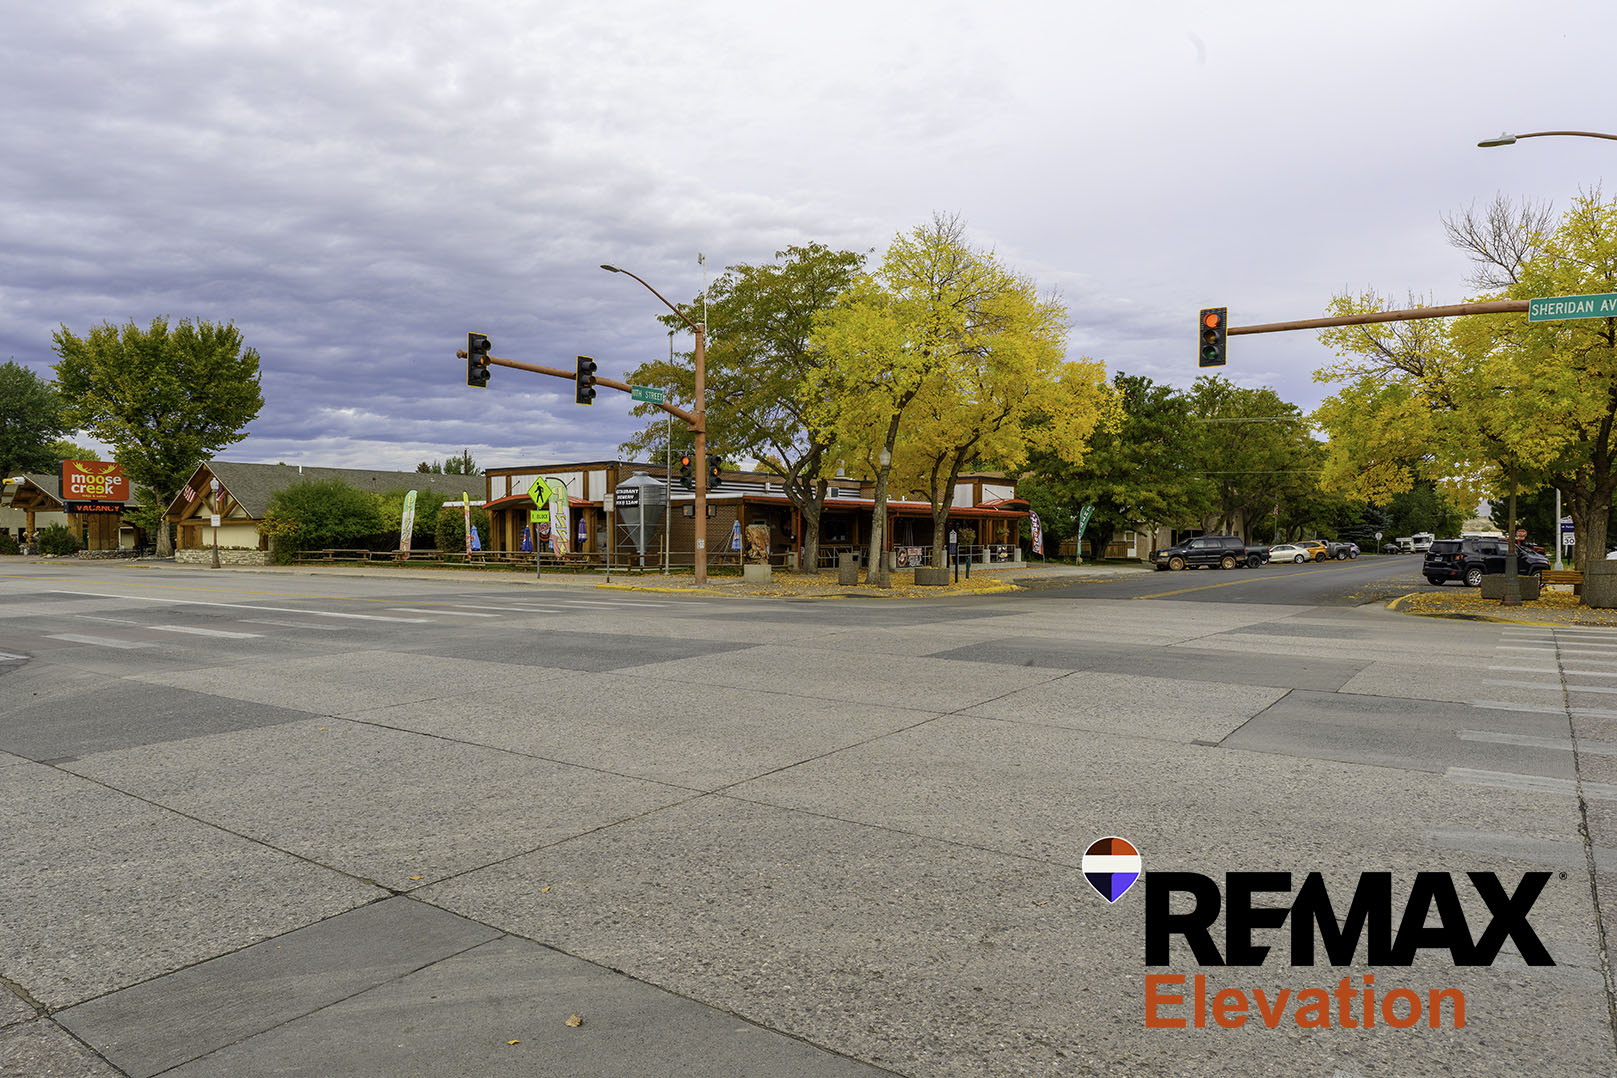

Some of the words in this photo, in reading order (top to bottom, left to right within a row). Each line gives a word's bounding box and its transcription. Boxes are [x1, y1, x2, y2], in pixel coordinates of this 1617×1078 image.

[1531, 300, 1594, 317] SHERIDAN
[645, 391, 663, 402] STREET
[71, 474, 122, 486] moose
[71, 482, 114, 495] creek
[76, 504, 120, 512] VACANCY
